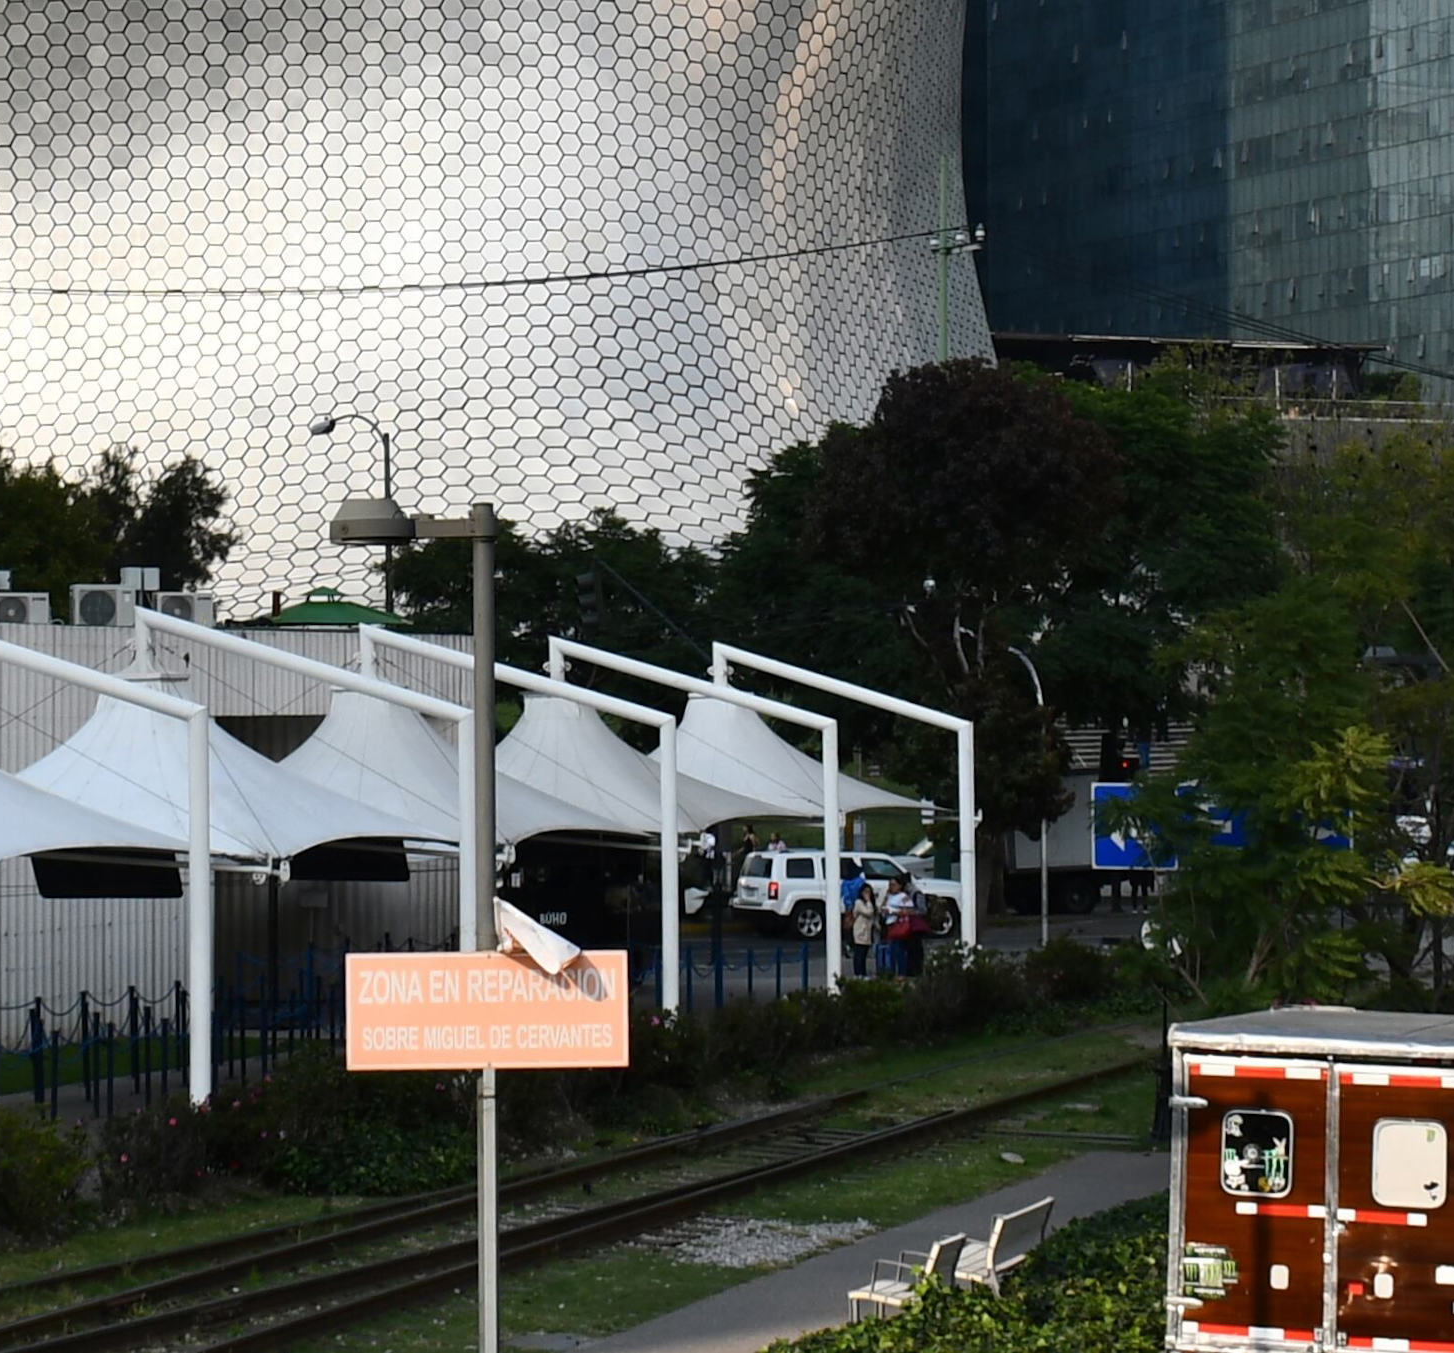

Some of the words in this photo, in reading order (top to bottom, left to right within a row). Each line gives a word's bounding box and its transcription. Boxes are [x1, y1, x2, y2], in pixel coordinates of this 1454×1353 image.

[358, 969, 424, 1005] ZONA
[429, 969, 461, 1004] EN
[362, 1026, 419, 1051] SOBRE
[424, 1024, 485, 1050] MIGUEL
[489, 1024, 512, 1049] DE
[516, 1023, 613, 1049] CERVANTES
